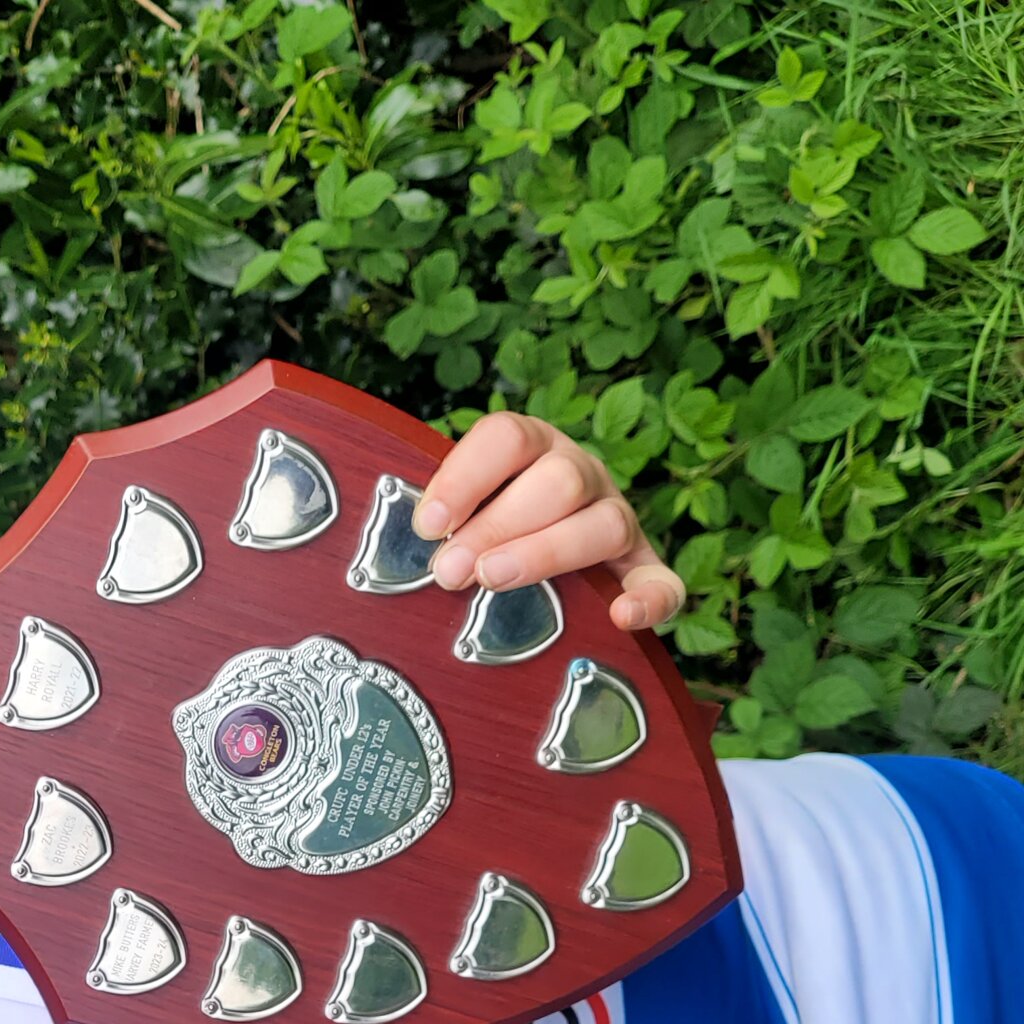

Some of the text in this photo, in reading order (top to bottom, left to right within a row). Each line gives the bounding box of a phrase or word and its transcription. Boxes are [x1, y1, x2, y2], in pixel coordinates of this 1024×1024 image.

[26, 658, 45, 695] HARRY
[41, 663, 62, 703] ROYALL
[61, 666, 81, 709] 2021-22
[259, 725, 280, 771] CONGLETON
[269, 738, 282, 762] BEARS
[327, 787, 348, 823] CRUFC
[342, 743, 364, 781] UNDER
[339, 719, 391, 837] PLAYER OF THE YEAR
[364, 750, 393, 815] SPONSORED BY
[391, 760, 419, 820] CARPENTRY &
[408, 776, 426, 813] JOINERY
[378, 790, 395, 814] JOHN
[41, 825, 56, 845] ZAC
[55, 815, 76, 864] BROOKES
[111, 914, 139, 976] MIKE BUTTERS
[148, 939, 167, 973] 2023-24
